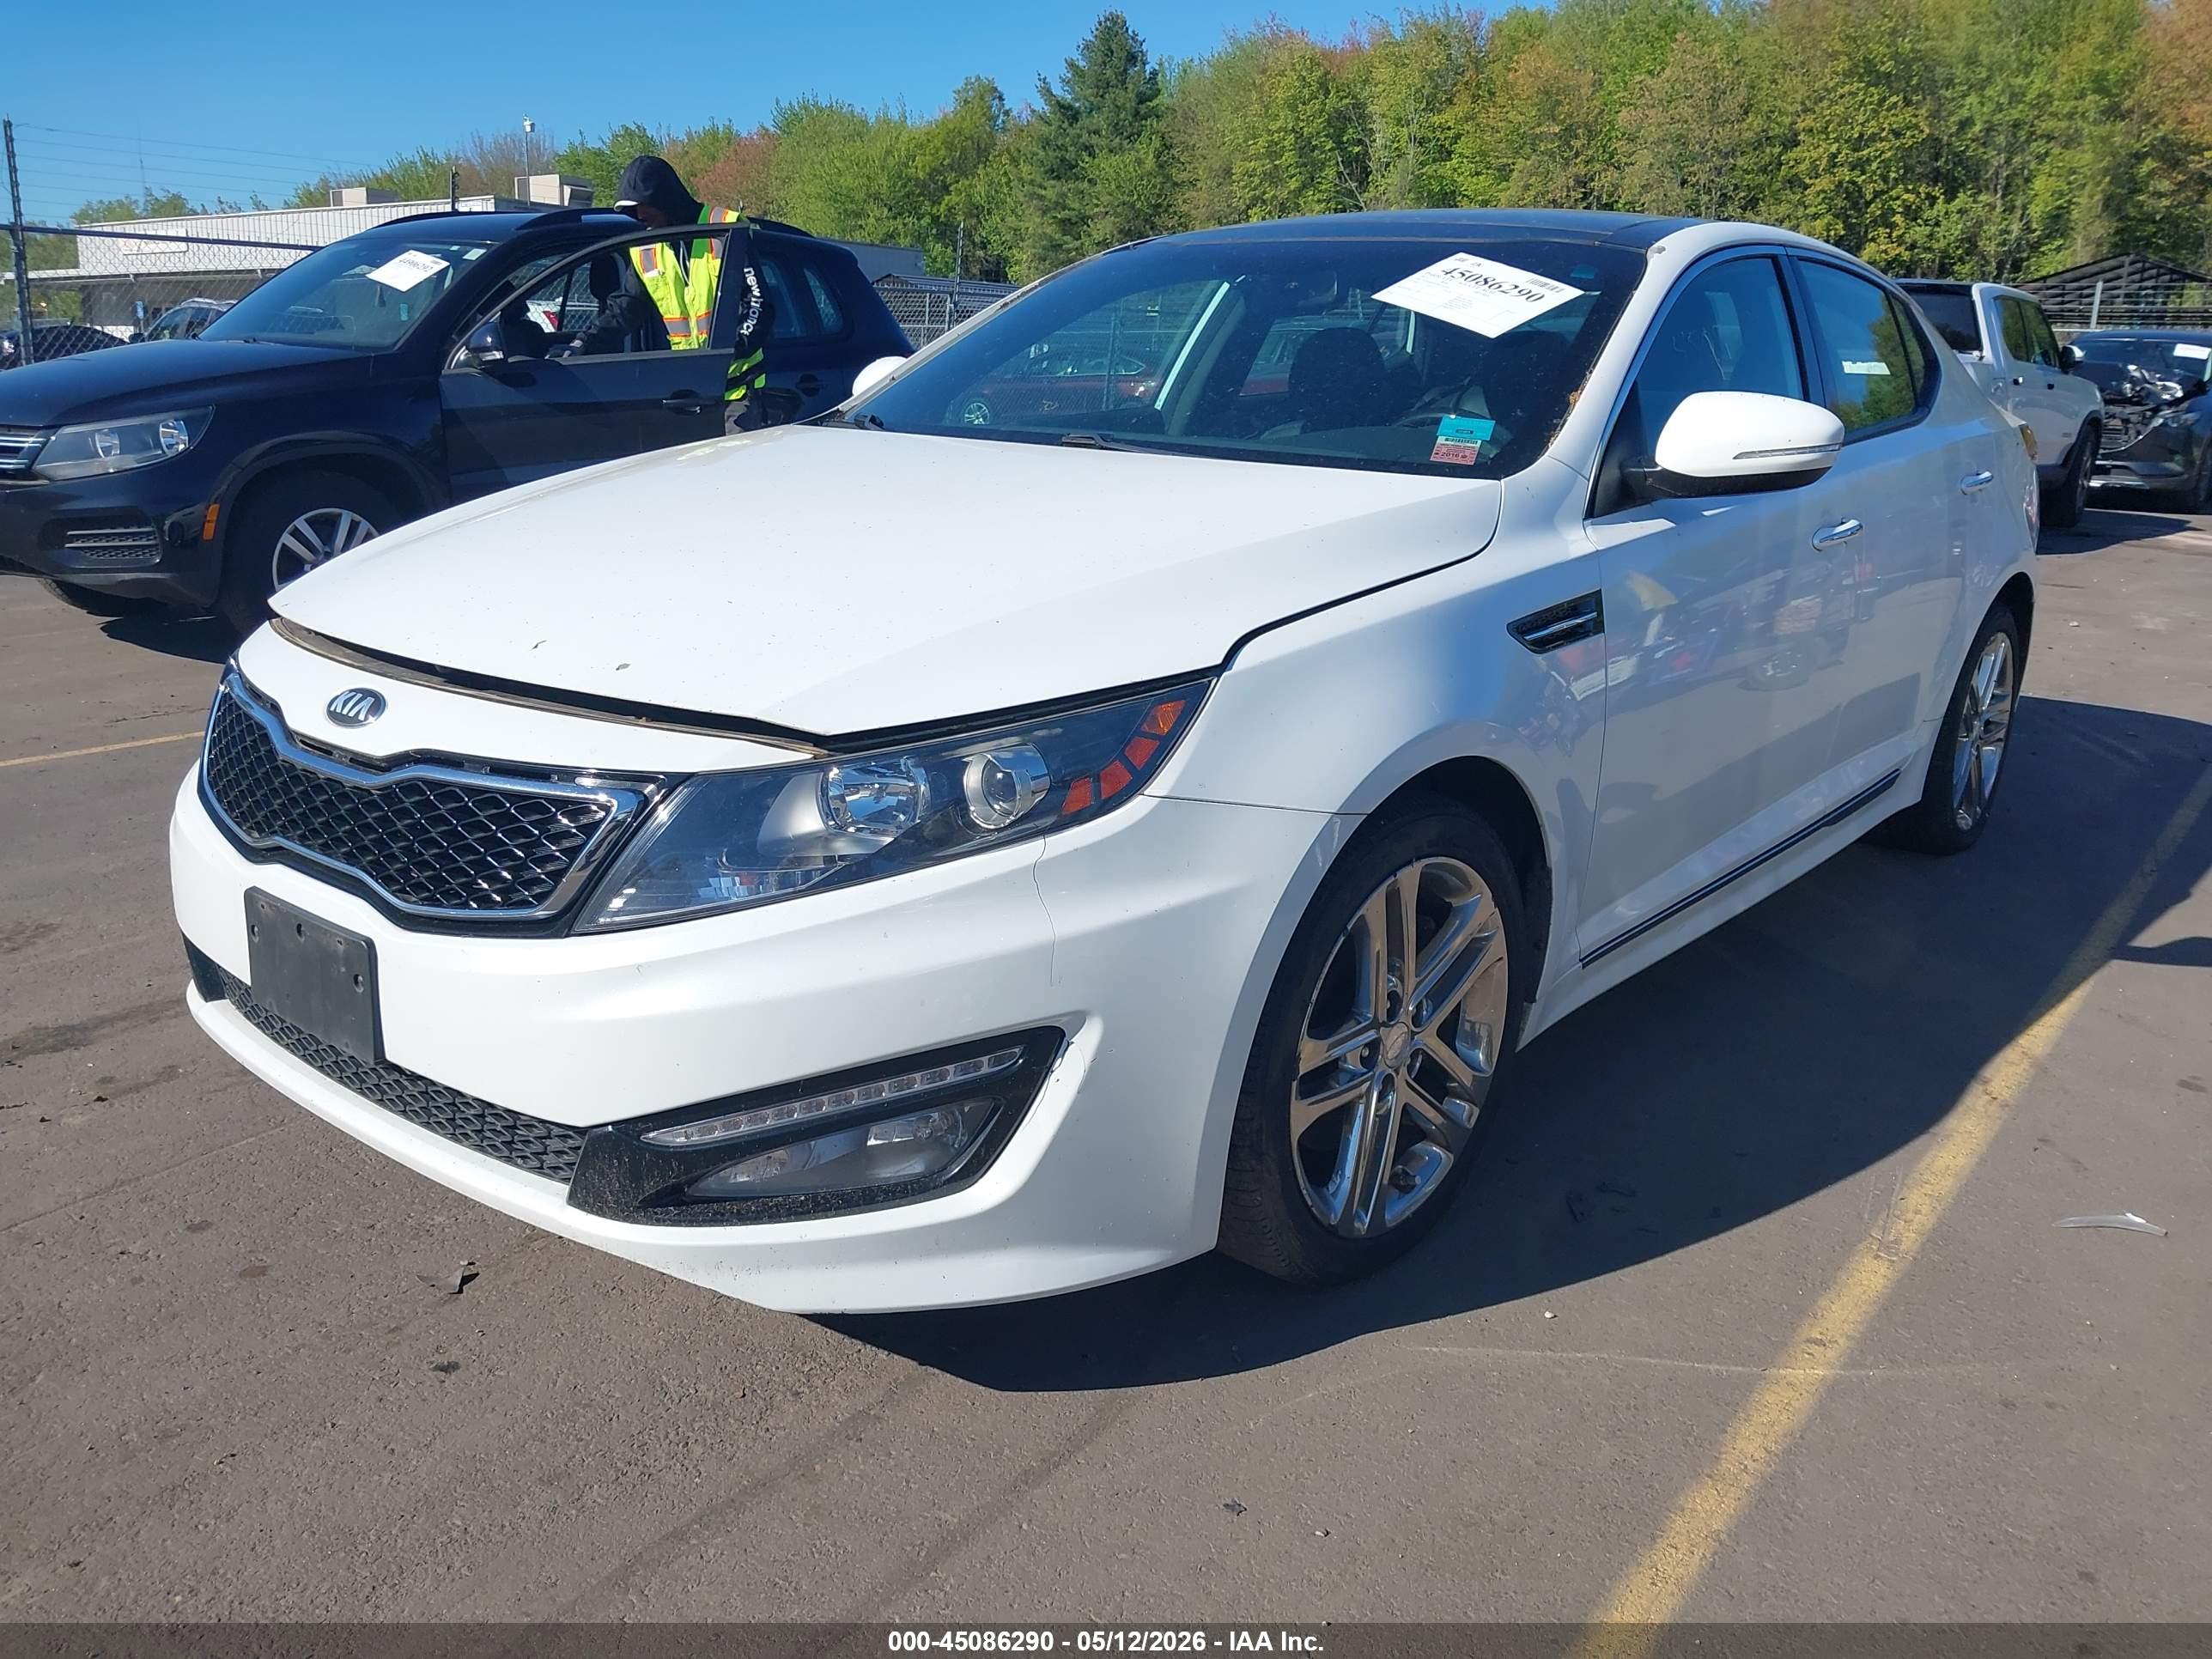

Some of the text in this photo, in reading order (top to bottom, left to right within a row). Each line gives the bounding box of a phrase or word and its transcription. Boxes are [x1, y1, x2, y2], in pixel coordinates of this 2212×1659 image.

[744, 267, 761, 297] new
[1442, 266, 1546, 303] 45086290
[330, 690, 375, 721] KIA
